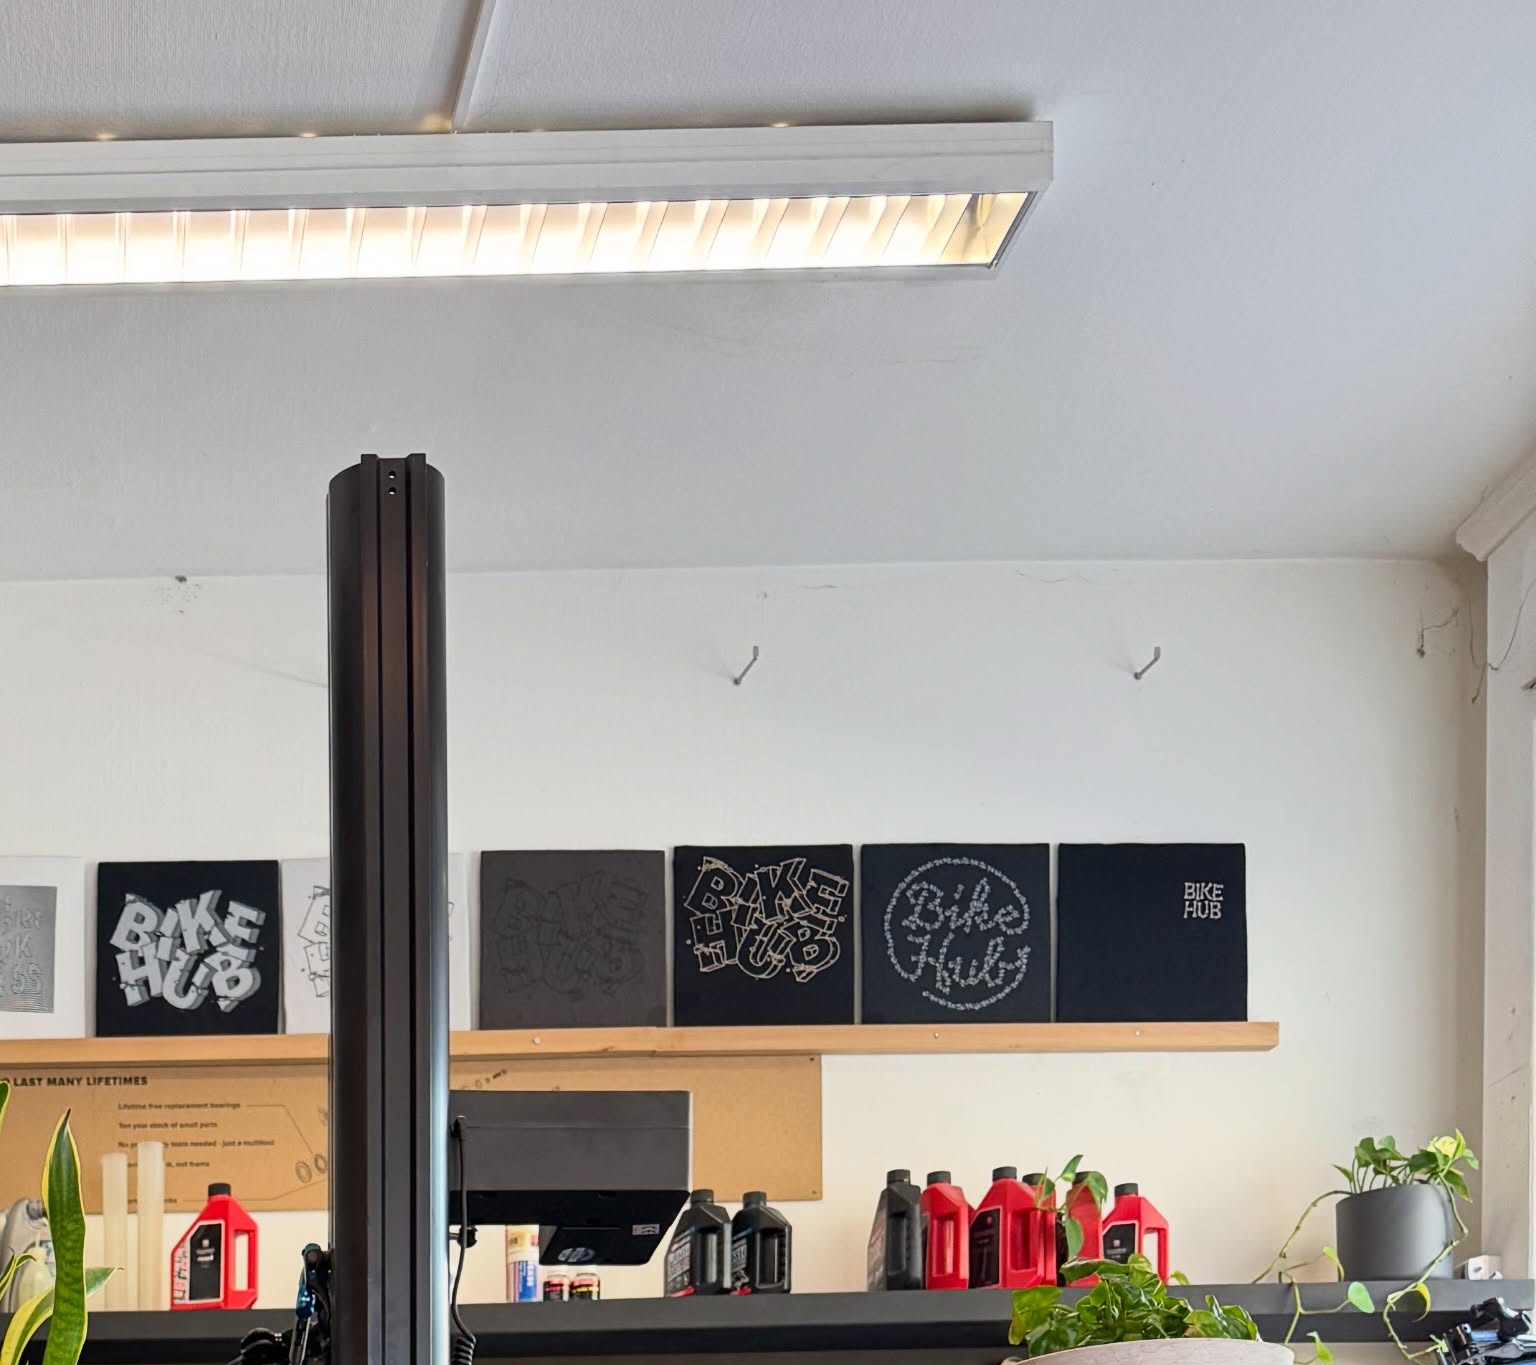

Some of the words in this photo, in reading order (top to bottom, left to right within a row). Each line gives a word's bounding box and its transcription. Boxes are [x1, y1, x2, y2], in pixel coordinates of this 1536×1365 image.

[684, 856, 850, 928] BIKE
[902, 877, 1031, 936] Bike
[1183, 881, 1224, 902] BIKE
[1183, 900, 1222, 920] HUB
[109, 889, 266, 961] BIKE
[690, 908, 841, 983] HUB
[114, 944, 261, 1014] HUB
[905, 932, 1031, 995] Hub
[14, 1077, 44, 1087] LAST
[46, 1077, 83, 1087] MANY
[86, 1076, 148, 1087] LIFETIMES
